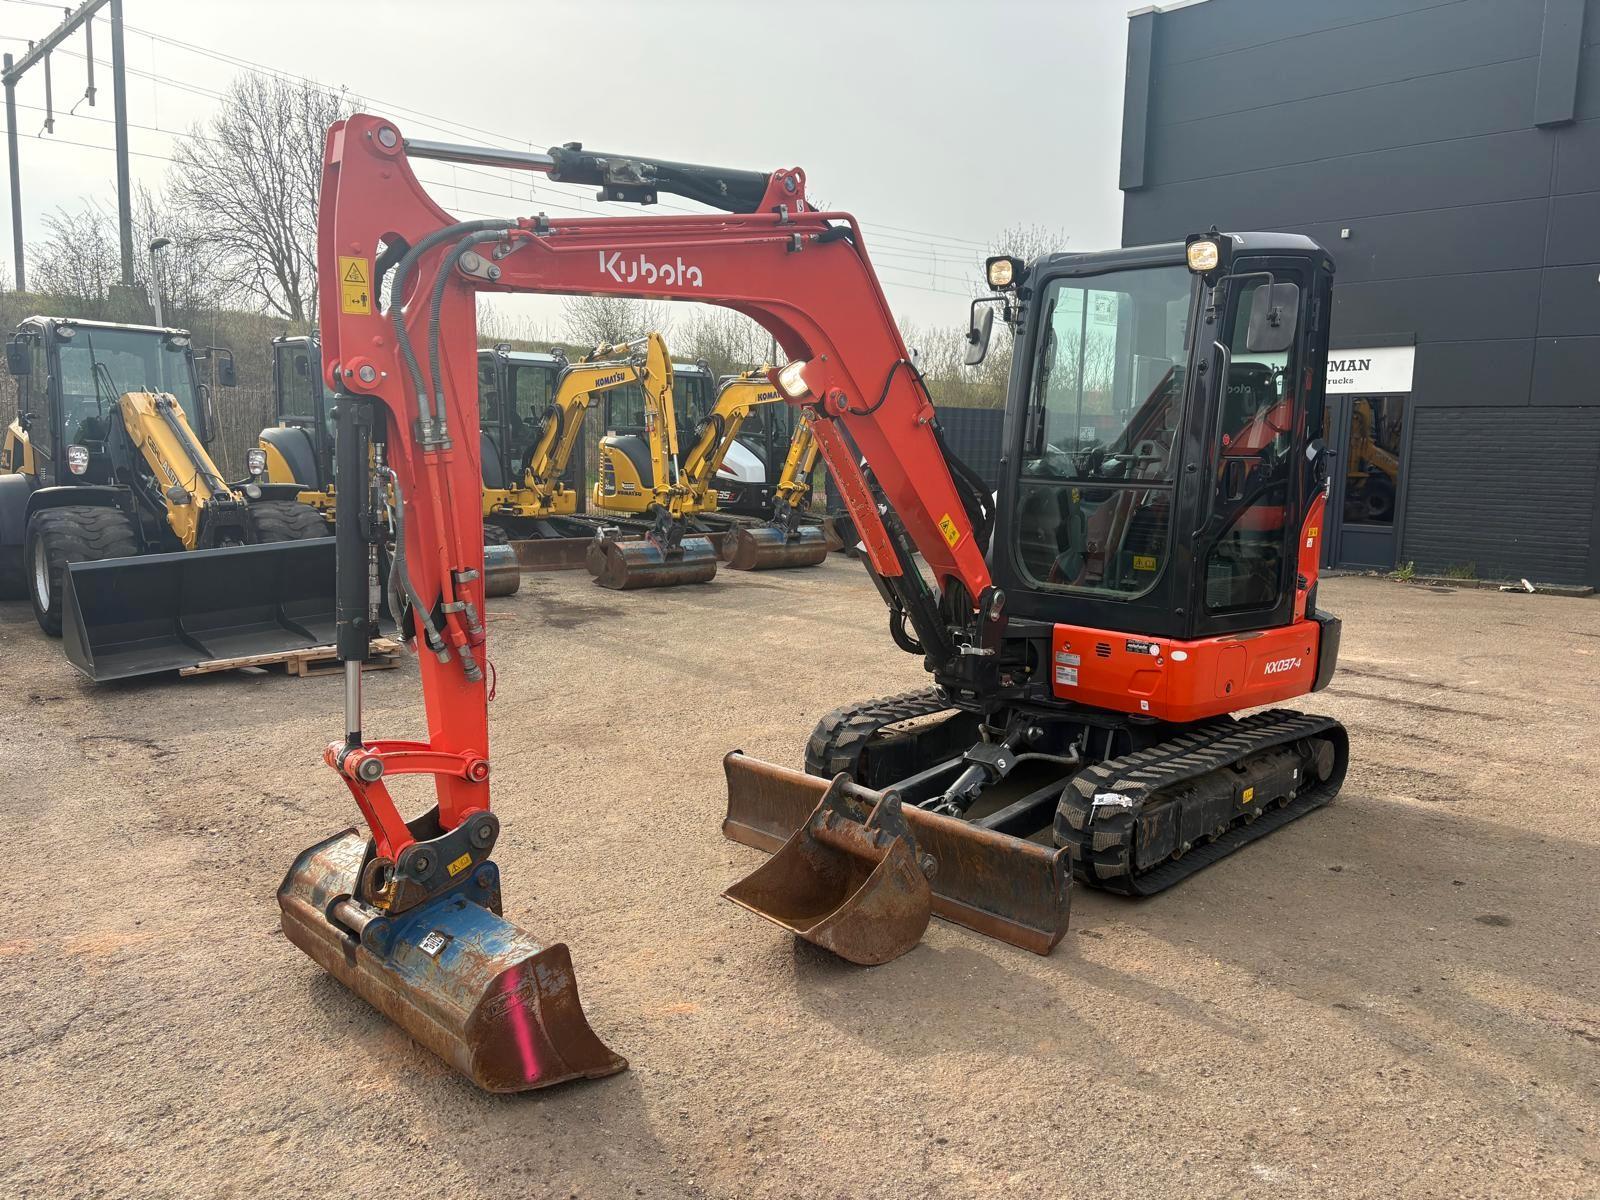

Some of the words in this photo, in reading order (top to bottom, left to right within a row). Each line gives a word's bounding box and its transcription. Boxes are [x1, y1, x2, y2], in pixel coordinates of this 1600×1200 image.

[599, 251, 702, 287] Kubota
[1327, 359, 1371, 372] MAN
[595, 372, 625, 387] KOMATSU
[1326, 377, 1354, 385] rucks
[1264, 658, 1302, 675] KX037-4
